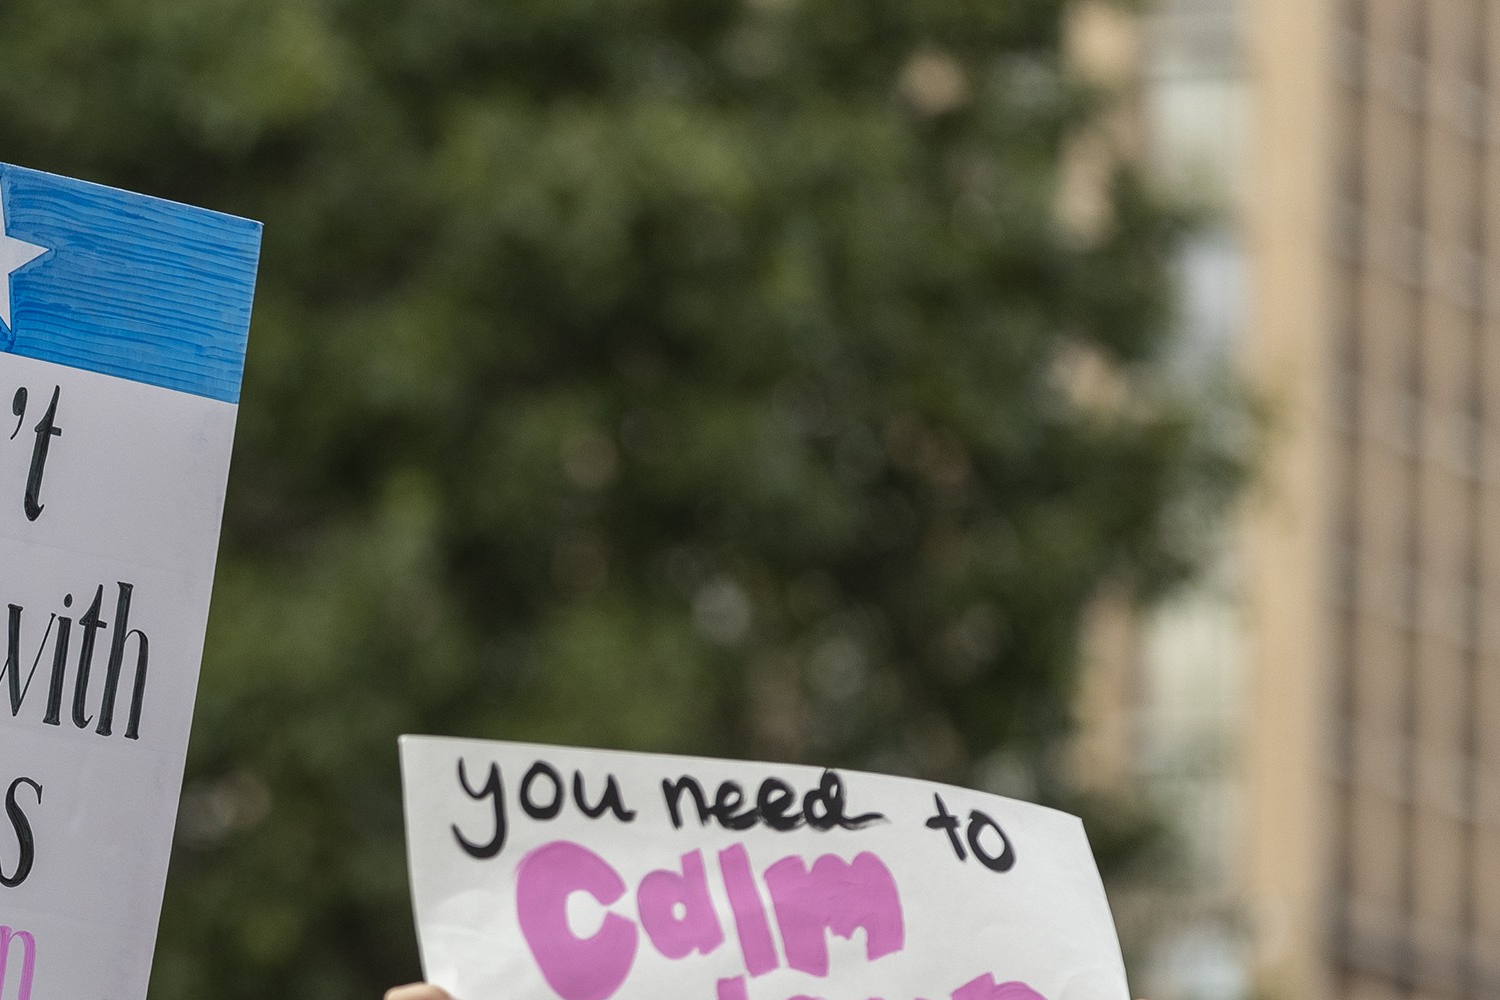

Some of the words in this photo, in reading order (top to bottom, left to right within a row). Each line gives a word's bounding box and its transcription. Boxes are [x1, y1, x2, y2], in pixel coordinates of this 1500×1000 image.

[453, 757, 636, 859] you
[663, 768, 890, 831] need
[925, 793, 1015, 873] to
